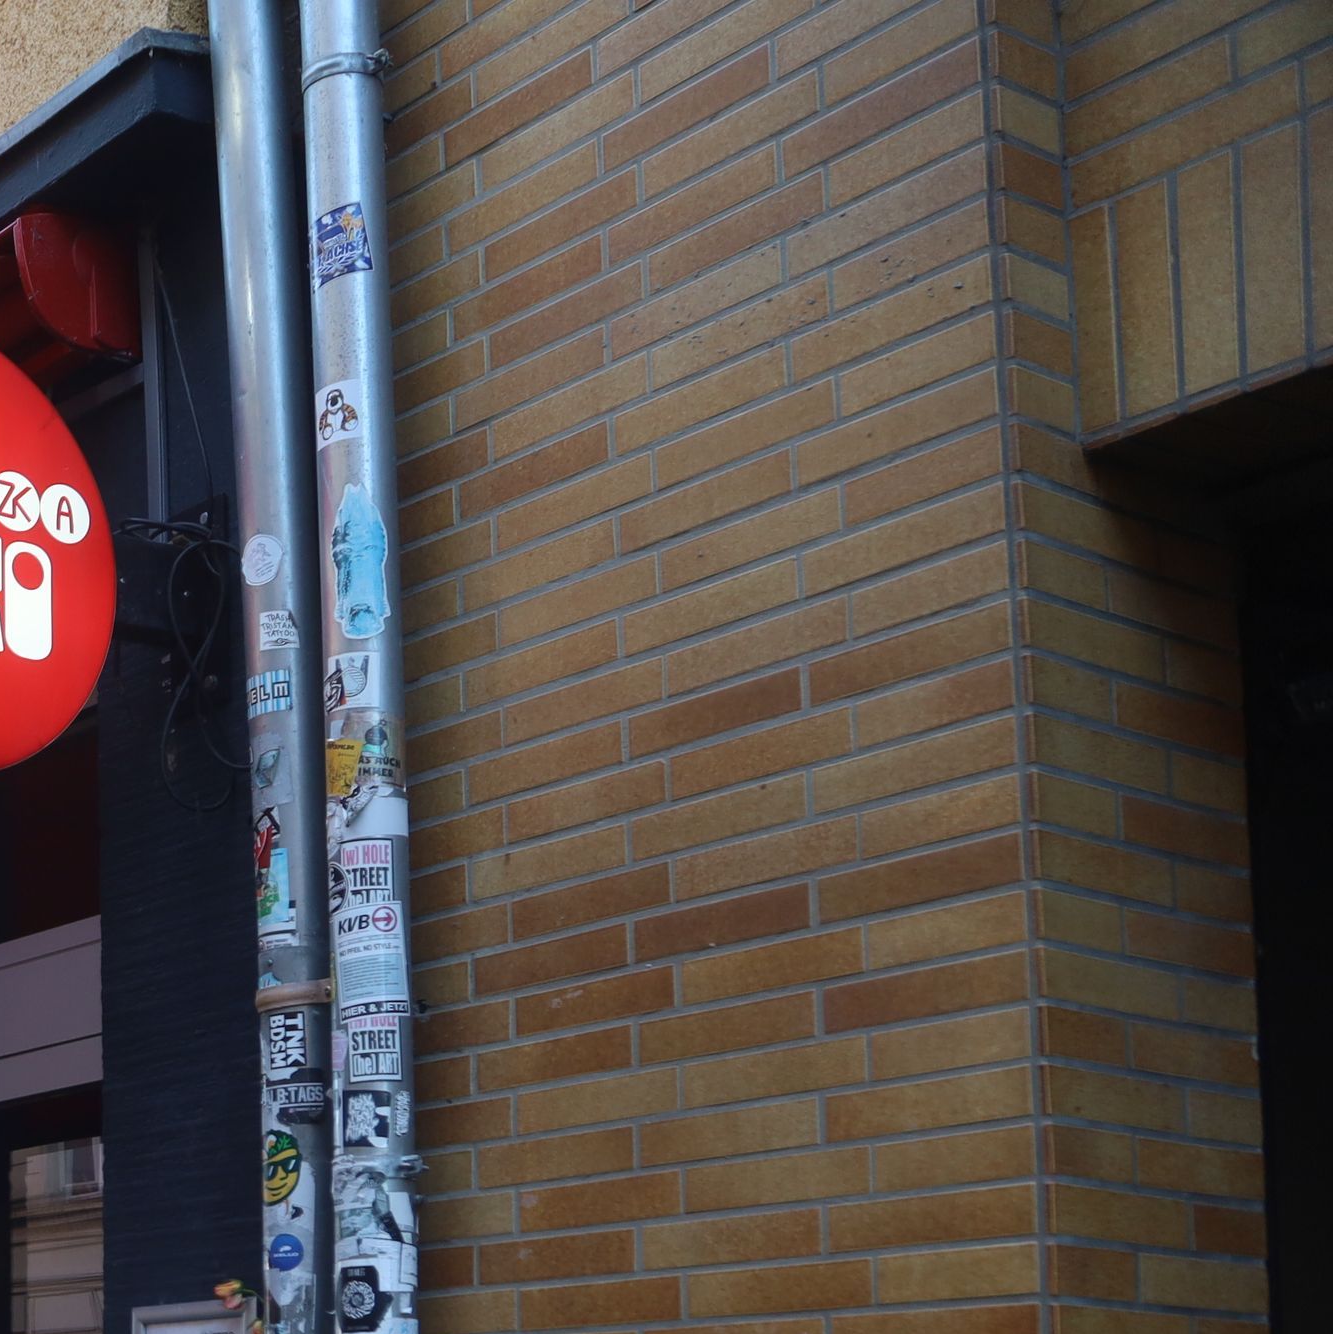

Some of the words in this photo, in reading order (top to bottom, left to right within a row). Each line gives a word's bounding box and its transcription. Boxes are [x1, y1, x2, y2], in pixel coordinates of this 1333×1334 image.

[338, 915, 370, 935] KVB
[342, 1005, 368, 1018] HIER
[369, 1004, 379, 1013] &
[270, 1014, 287, 1068] BDSM
[285, 1013, 306, 1066] TNK
[352, 1030, 397, 1051] STREET
[378, 1052, 398, 1074] ART
